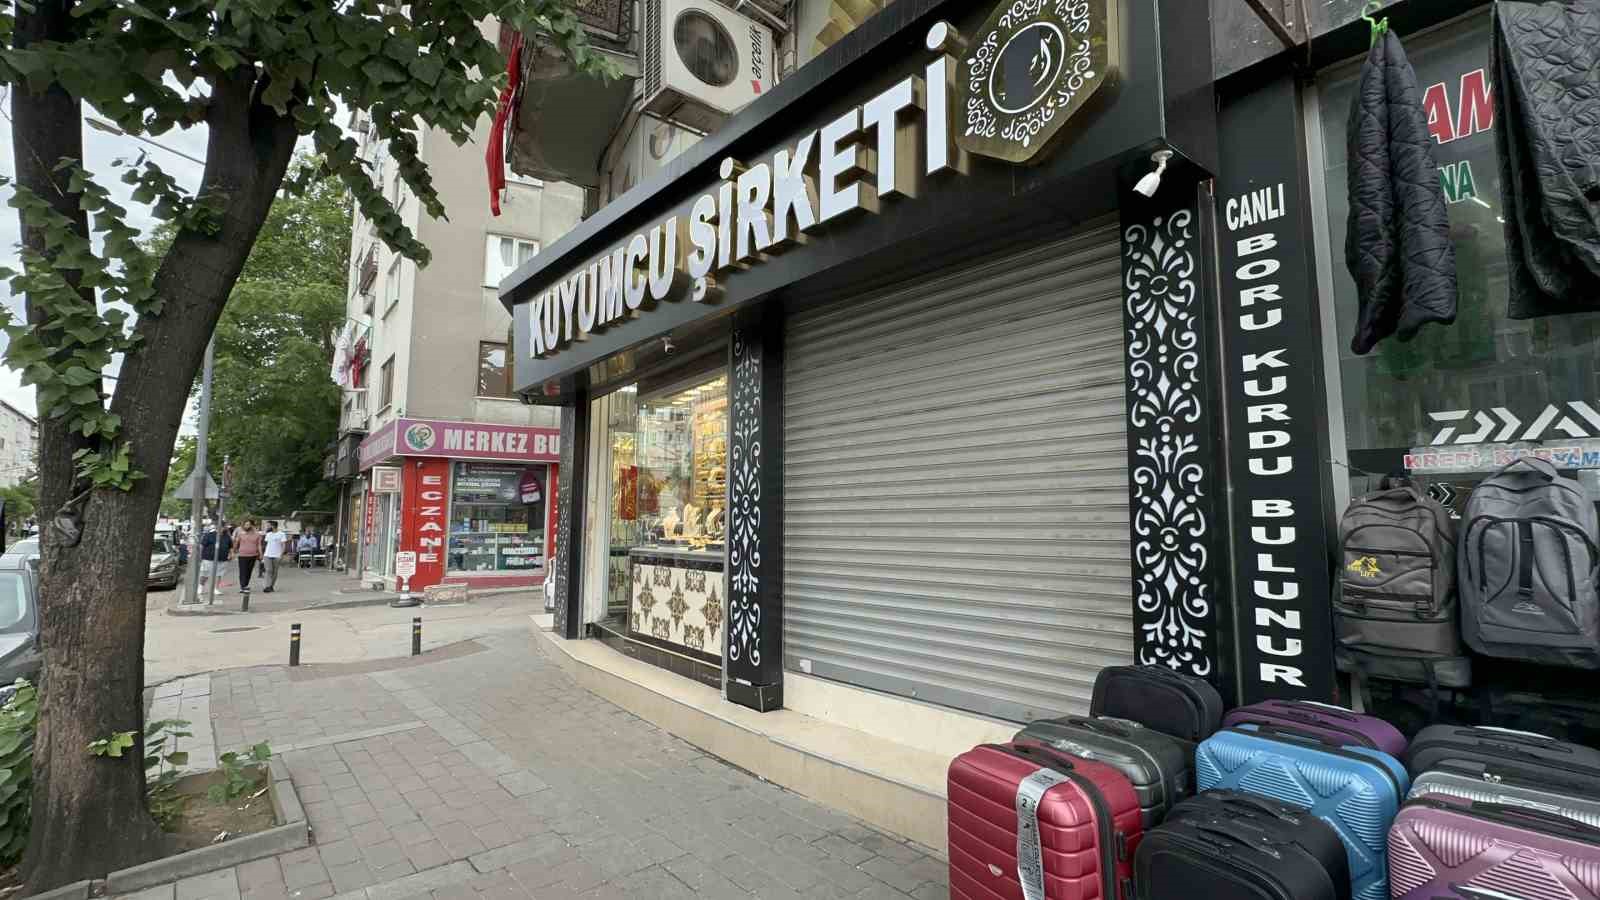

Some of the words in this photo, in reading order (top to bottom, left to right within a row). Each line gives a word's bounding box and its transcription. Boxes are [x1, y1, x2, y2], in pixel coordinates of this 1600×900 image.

[749, 24, 764, 79] arçelik
[528, 215, 677, 358] KUYUMCU
[688, 20, 951, 302] ŞİRKETİ
[1226, 183, 1286, 231] CANLI
[1235, 232, 1283, 332] BORU
[443, 428, 529, 454] MERKEZ
[1243, 349, 1292, 476] KURDU
[418, 474, 443, 563] ECZANE
[1251, 499, 1306, 688] BULUNUR
